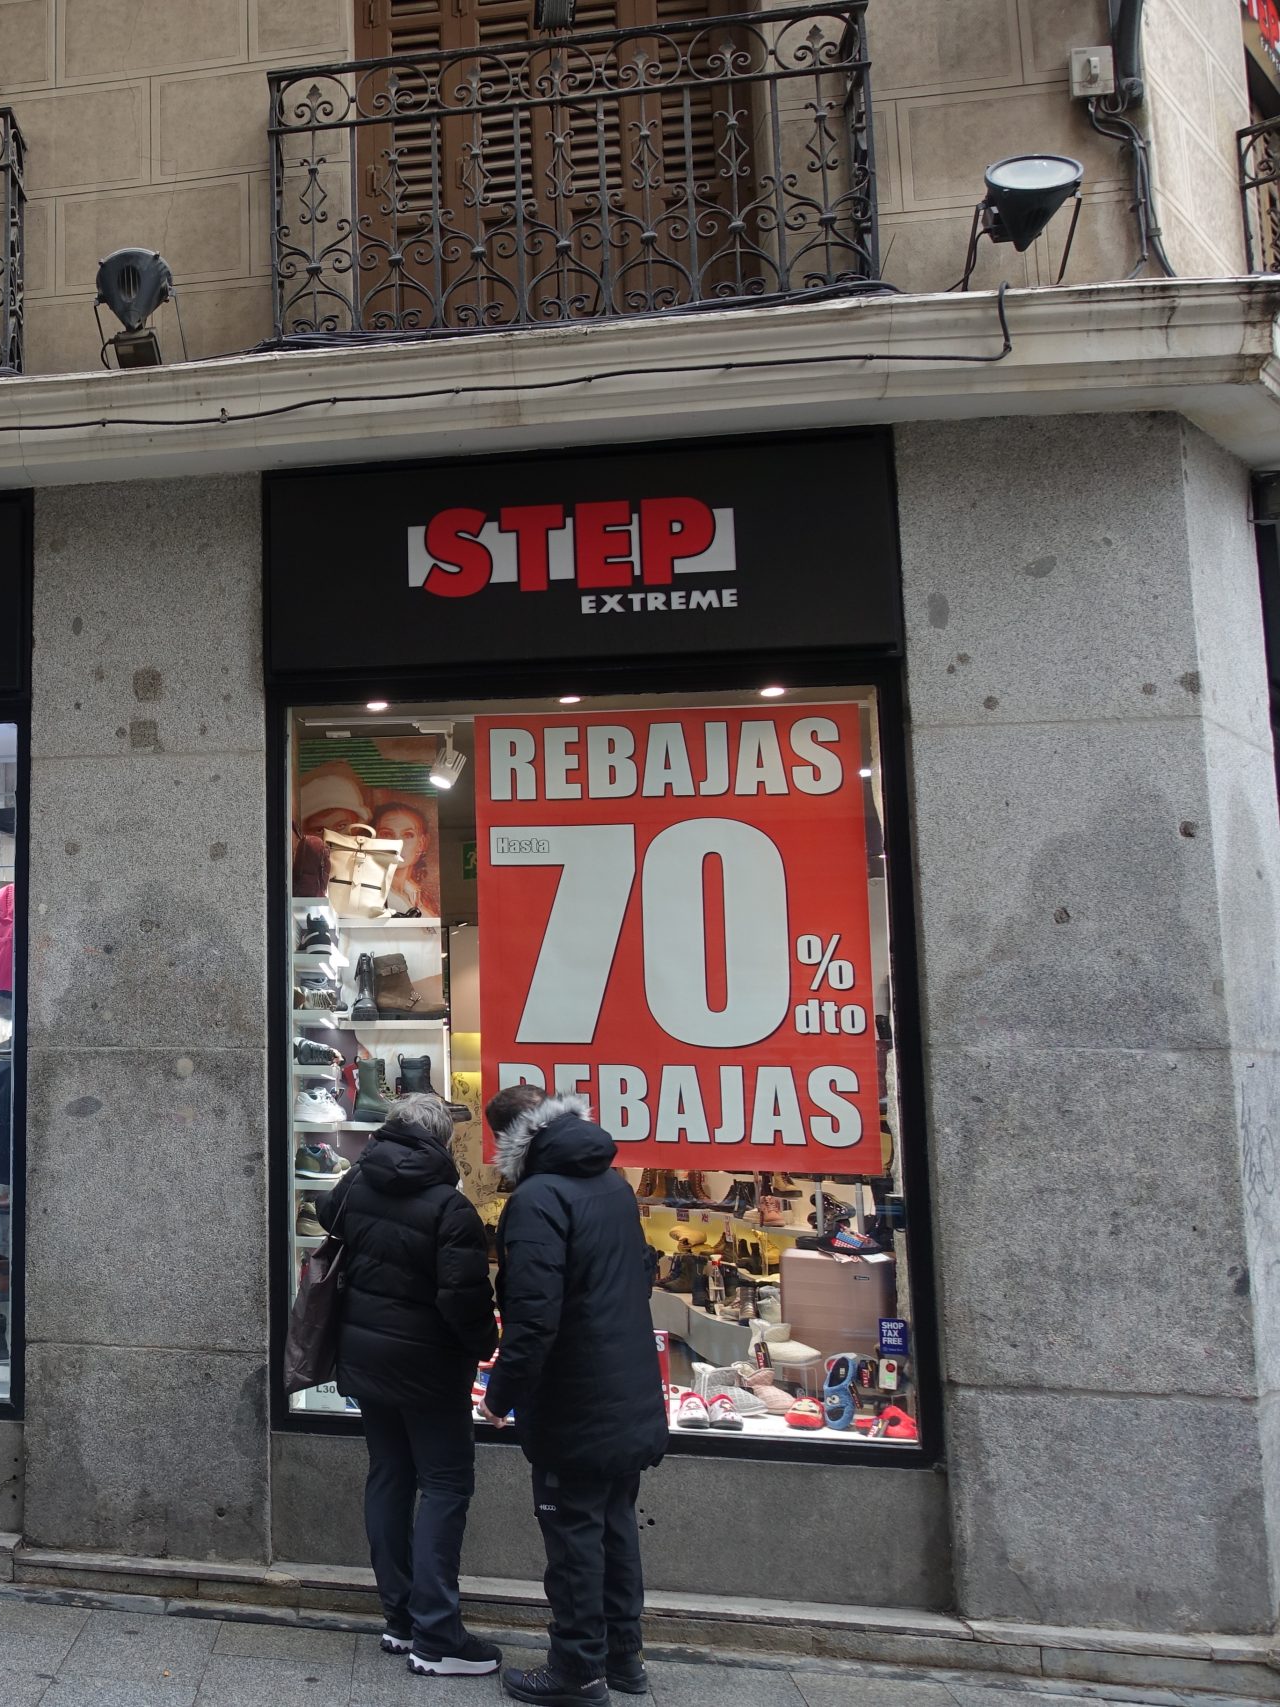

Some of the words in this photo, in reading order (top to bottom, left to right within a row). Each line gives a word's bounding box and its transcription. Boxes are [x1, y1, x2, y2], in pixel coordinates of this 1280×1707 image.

[423, 496, 716, 598] STEP
[580, 588, 738, 614] EXTREME
[489, 717, 843, 801] REBAJAS
[496, 837, 550, 854] Hasta
[489, 817, 791, 1049] 70
[796, 934, 854, 991] %
[795, 999, 867, 1034] dto
[881, 1321, 904, 1330] SHOP
[882, 1329, 899, 1337] TAX
[882, 1336, 903, 1345] FREE
